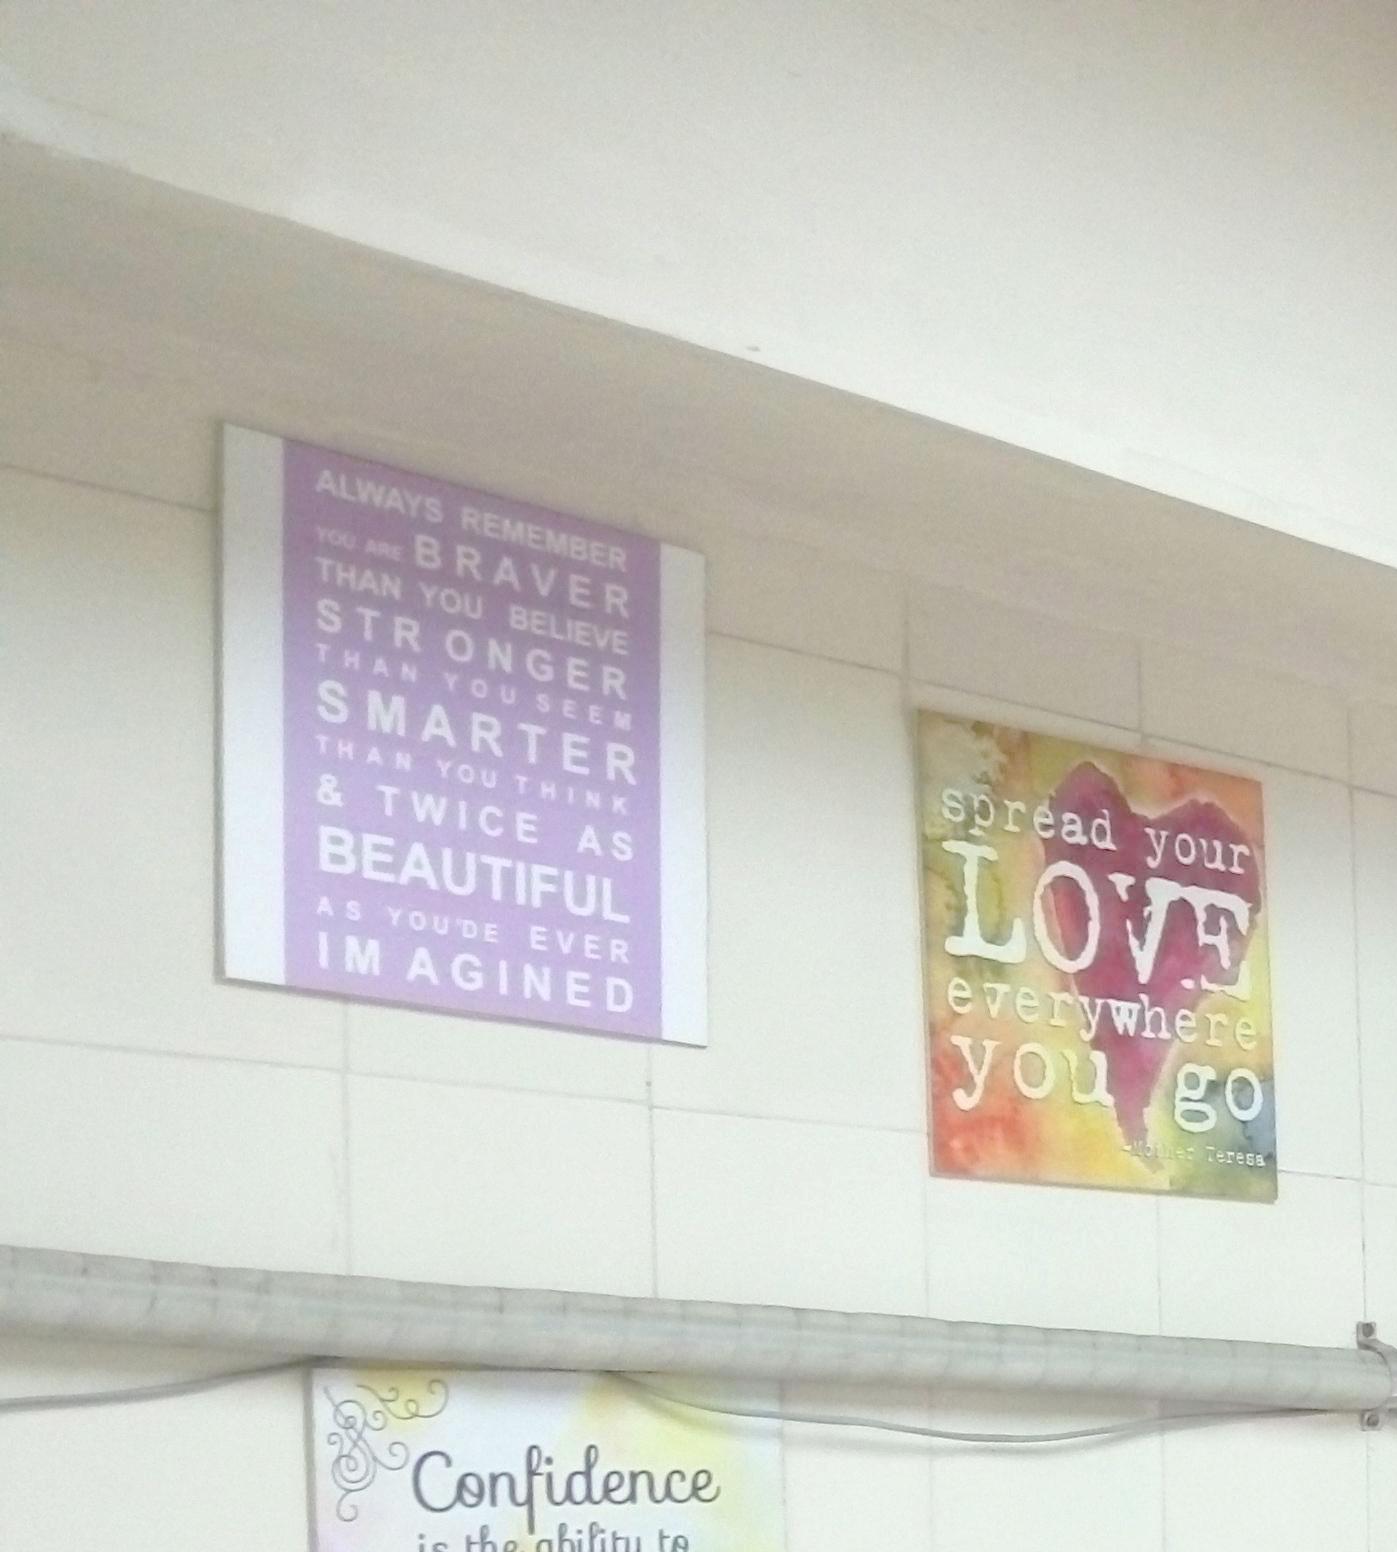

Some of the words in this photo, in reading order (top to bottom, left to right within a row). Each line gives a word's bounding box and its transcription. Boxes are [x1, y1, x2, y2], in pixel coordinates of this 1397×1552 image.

[316, 470, 444, 523] ALWAYS
[461, 506, 627, 573] REMEMBER
[315, 556, 402, 600] THAN
[419, 582, 483, 620] YOU
[509, 606, 629, 656] BELIEVE
[316, 526, 356, 549] YOU
[365, 539, 402, 562] ARE
[414, 533, 628, 618] BRAVER
[316, 598, 629, 700] STRONGER
[316, 644, 418, 683] THAN
[444, 673, 517, 705] YOU
[536, 694, 632, 732] SEEM
[315, 734, 413, 772] THAN
[437, 759, 498, 790] YOU
[515, 774, 629, 816] THINK
[317, 679, 638, 787] SMARTER
[316, 774, 344, 809] &
[383, 785, 540, 846] TWICE
[577, 825, 635, 863] AS
[940, 784, 1118, 852] spread
[1144, 825, 1253, 876] your
[318, 825, 631, 924] BEAUTIFUL
[942, 839, 1255, 1002] LOVE
[316, 896, 362, 922] AS
[529, 926, 629, 964] EVER
[318, 931, 634, 1013] IMAGINED
[946, 975, 1258, 1050] everywhere
[951, 1034, 1115, 1112] you
[1173, 1061, 1265, 1134] go
[1205, 1145, 1267, 1168] Teresa
[412, 1443, 722, 1535] Confidence
